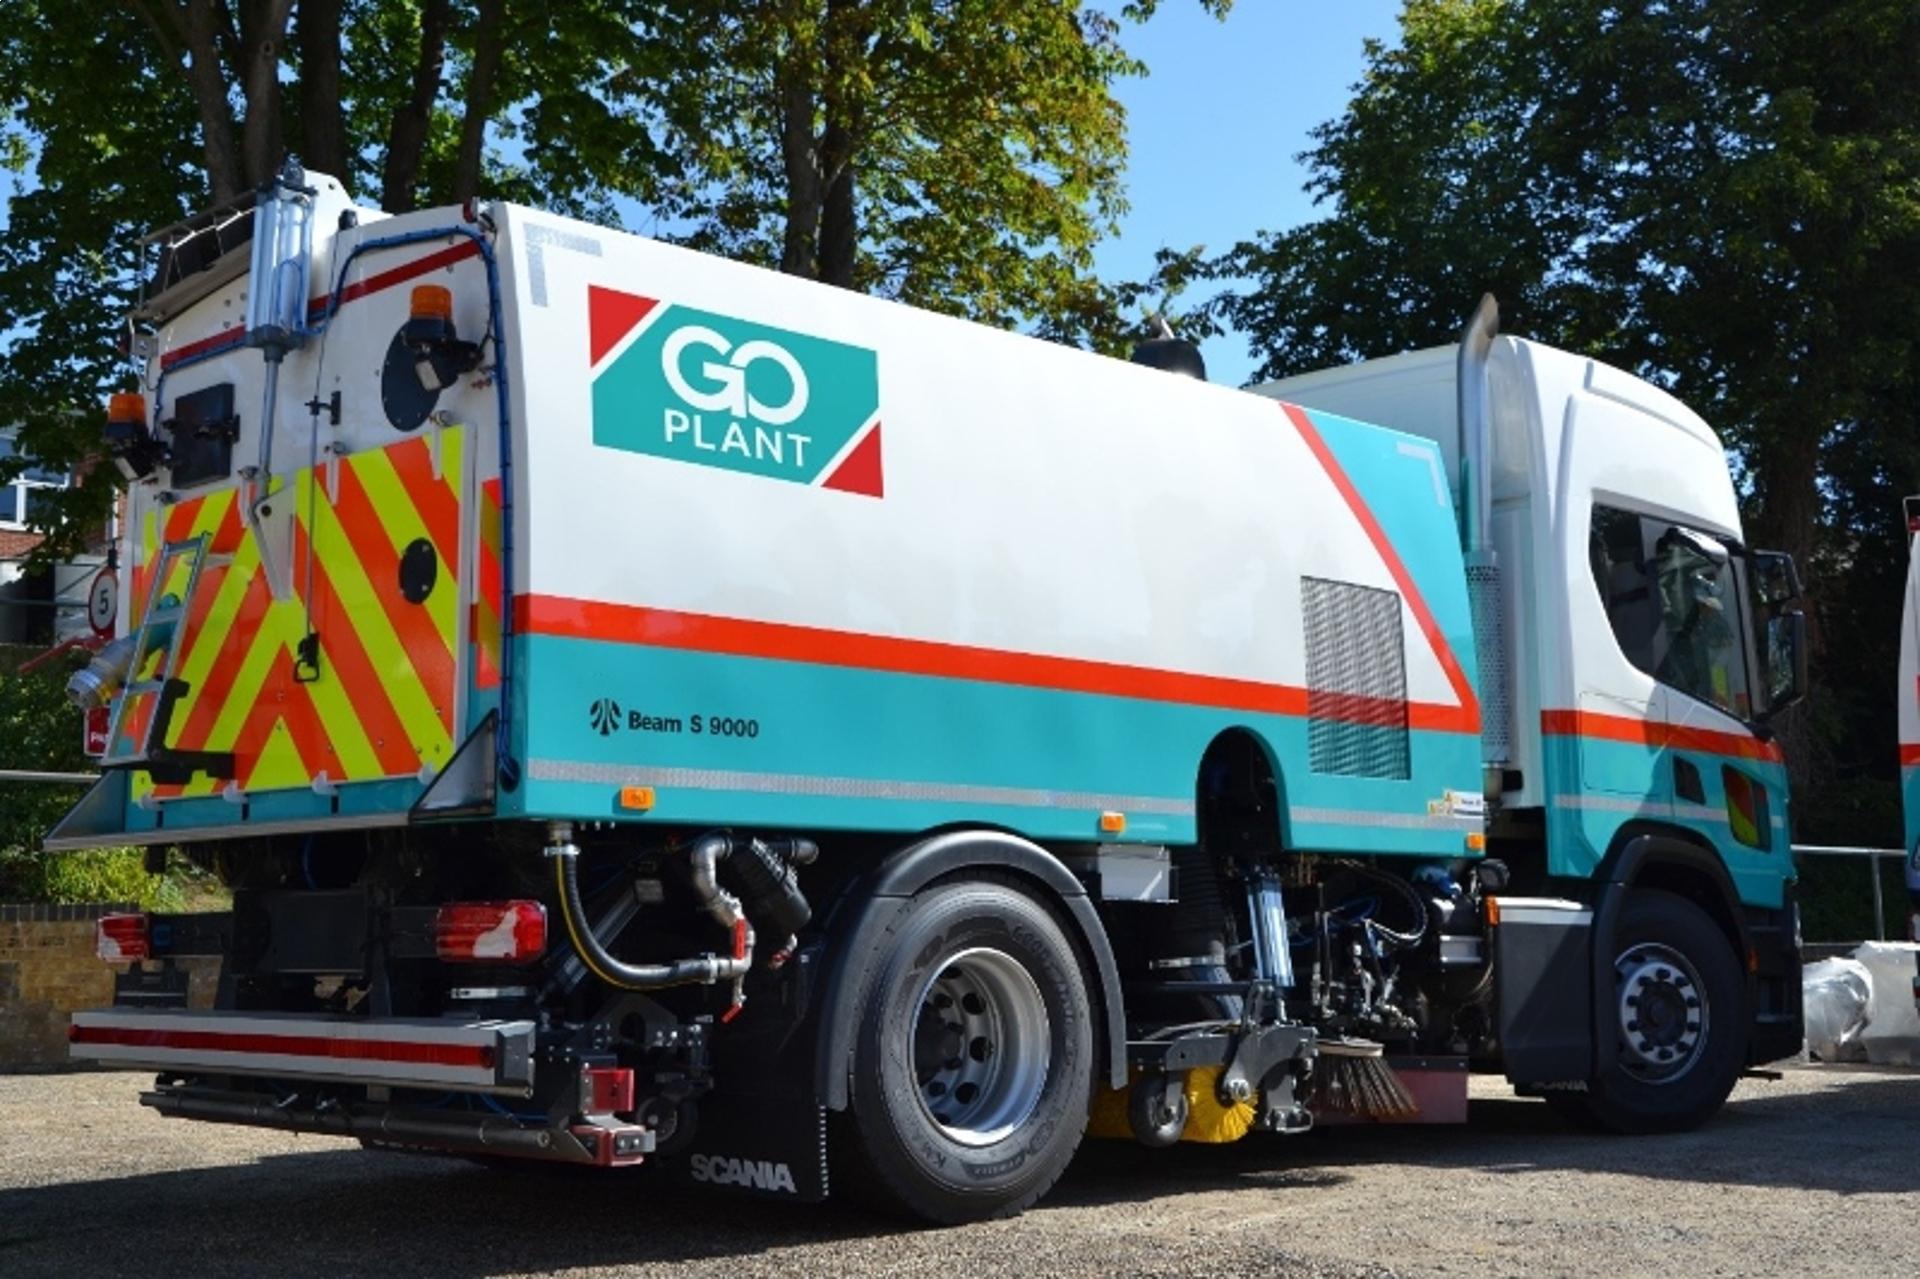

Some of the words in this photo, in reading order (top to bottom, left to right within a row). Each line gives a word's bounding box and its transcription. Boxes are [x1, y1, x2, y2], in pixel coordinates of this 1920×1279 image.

[661, 324, 810, 426] GO
[664, 408, 812, 468] PLANT
[99, 588, 109, 616] 5
[628, 710, 683, 733] Beam
[690, 714, 703, 734] S
[709, 716, 760, 738] 9000
[690, 1153, 797, 1193] SCANIA
